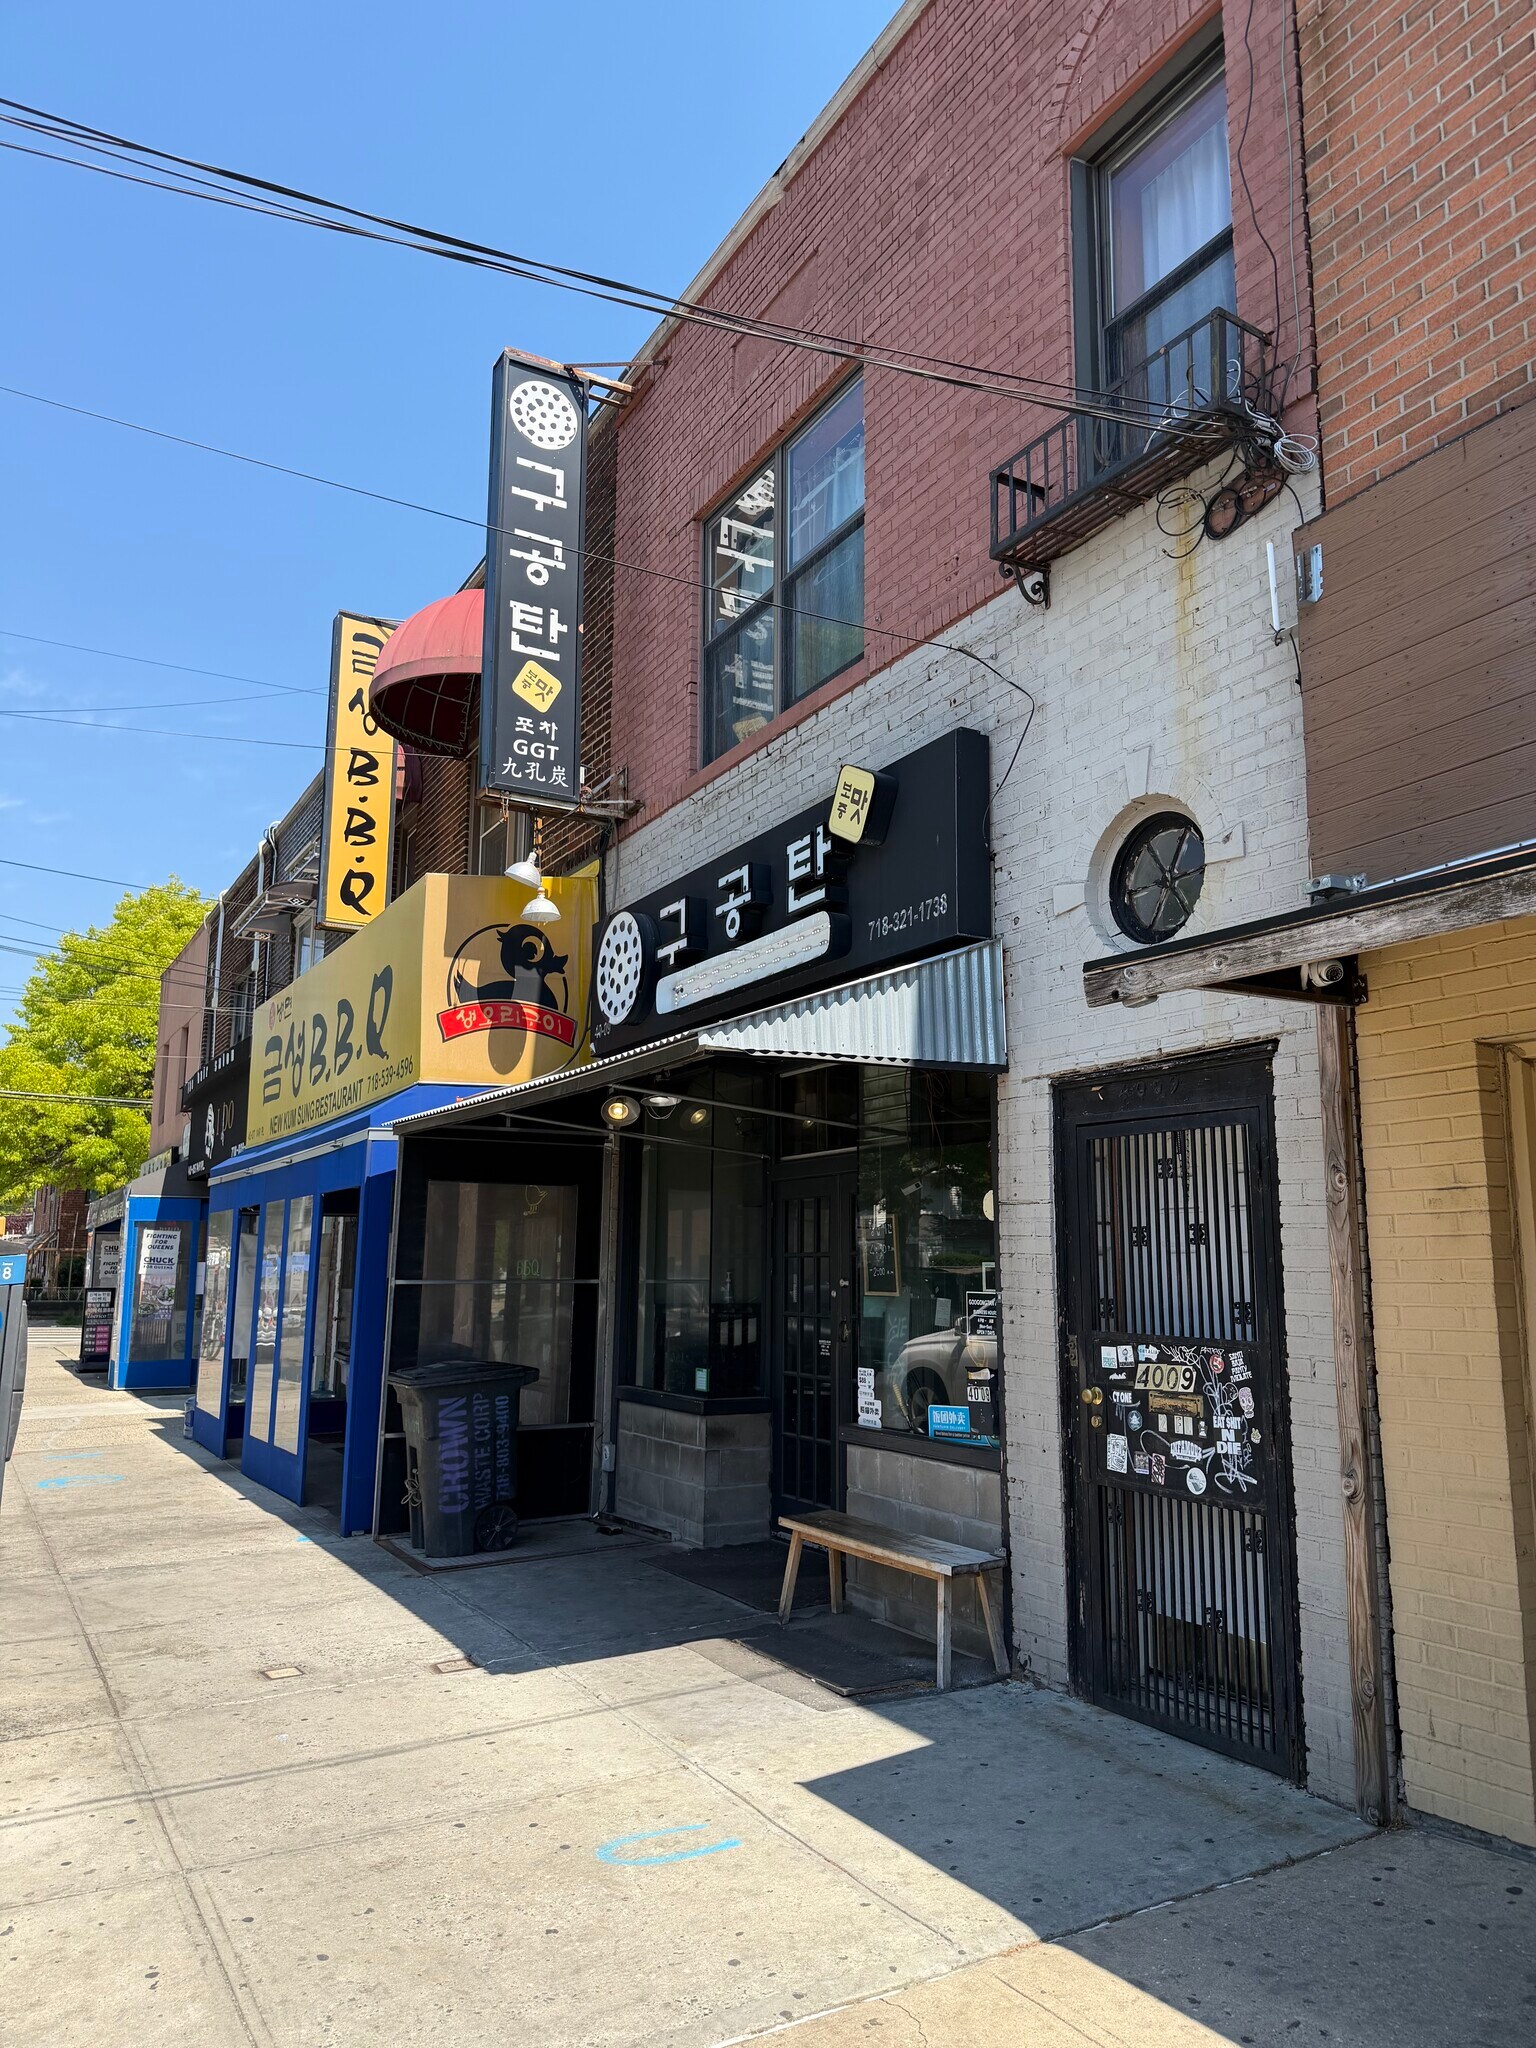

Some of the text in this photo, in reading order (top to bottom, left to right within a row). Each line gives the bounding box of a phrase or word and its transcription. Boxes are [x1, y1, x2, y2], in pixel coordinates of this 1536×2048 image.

[510, 456, 568, 662] 구공탄
[535, 678, 554, 702] 맛
[515, 716, 558, 741] 포차
[513, 739, 559, 761] GGT
[501, 756, 569, 788] 九孔炭
[837, 781, 853, 819] 보증
[850, 788, 868, 825] 맛
[657, 822, 832, 966] 구공탄
[868, 892, 948, 941] 718-321-1738
[456, 1005, 562, 1035] 생오리구이
[269, 1113, 283, 1136] NEW
[283, 1109, 297, 1131] KUM
[297, 1099, 315, 1125] SUNG
[315, 1078, 364, 1119] RESTAURANT
[367, 1055, 413, 1094] 718-539-4596
[143, 1256, 174, 1264] CHUCK
[1136, 1365, 1194, 1390] 4009
[932, 1410, 966, 1425] 饭团外卖
[1212, 1415, 1226, 1428] EAT
[1216, 1440, 1243, 1455] DIE
[1221, 1428, 1236, 1442] N
[437, 1396, 470, 1514] CROWN
[472, 1392, 491, 1511] WASTE CORP
